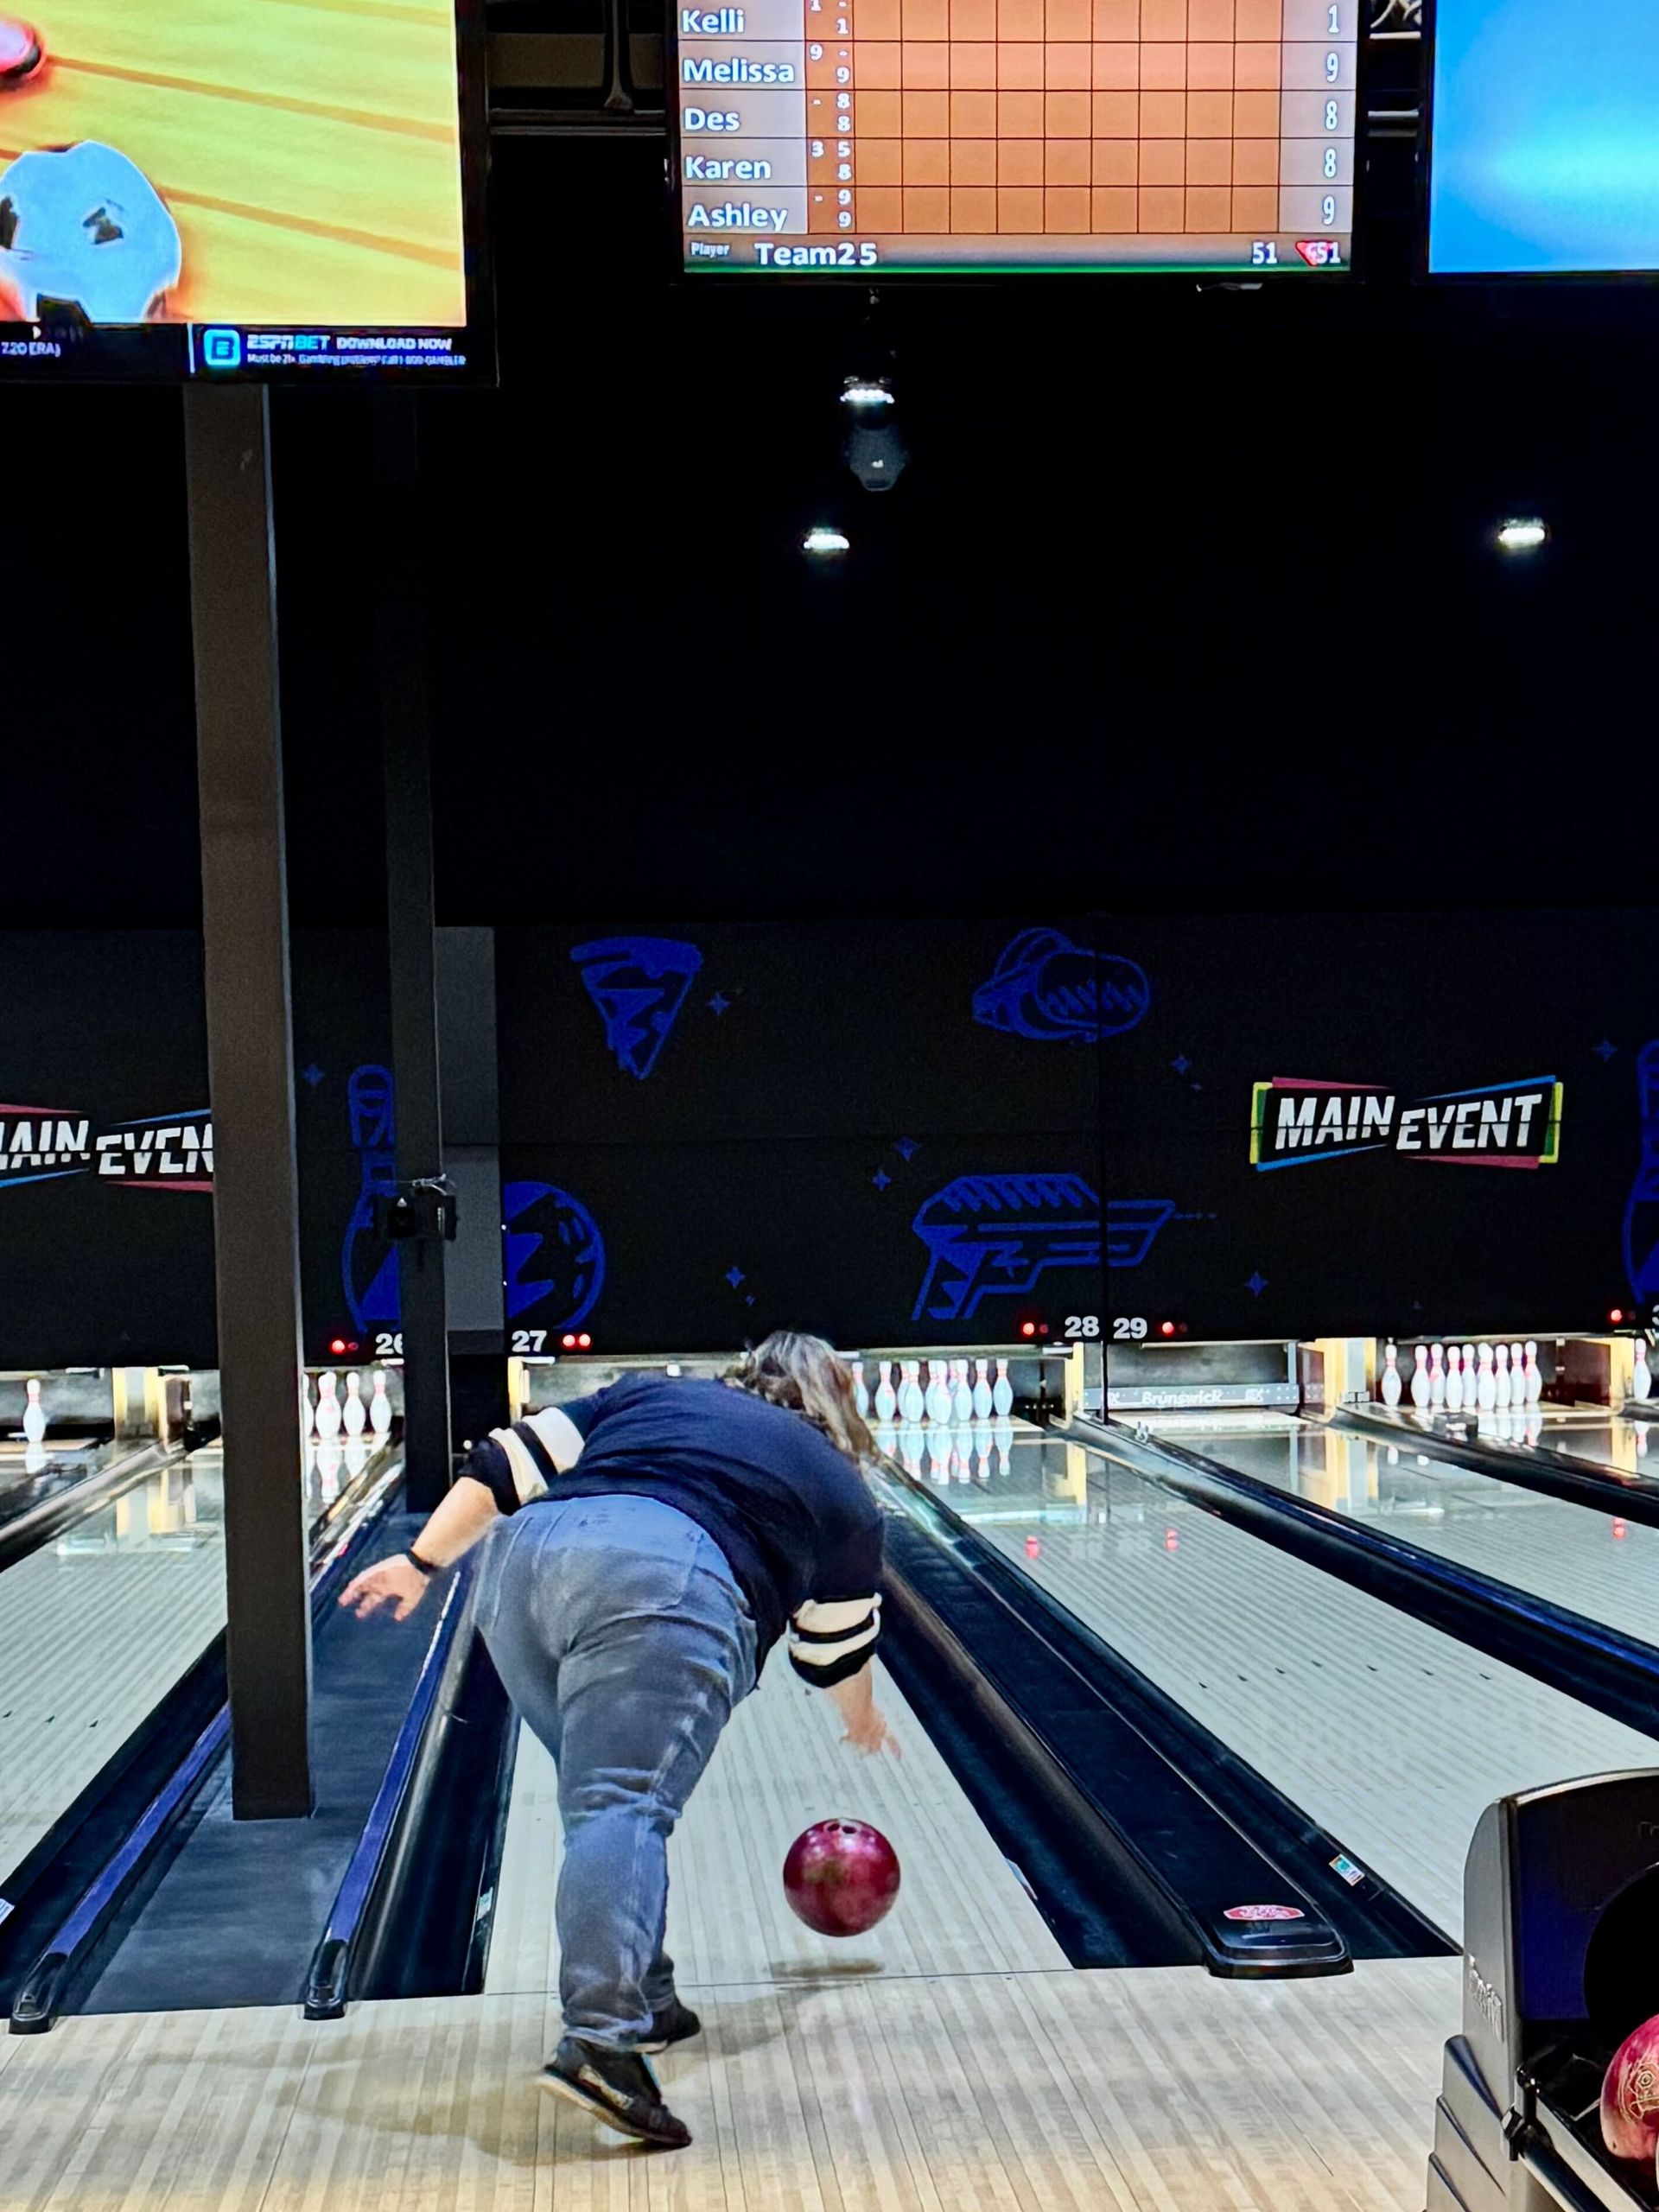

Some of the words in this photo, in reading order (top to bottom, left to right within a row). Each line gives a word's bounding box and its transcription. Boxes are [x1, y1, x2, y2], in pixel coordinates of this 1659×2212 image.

[682, 10, 745, 33] Kelli
[837, 18, 849, 35] 1
[1327, 4, 1339, 33] 1
[810, 44, 823, 60] 9
[683, 59, 795, 82] Melissa
[837, 67, 850, 83] 9
[1326, 53, 1338, 82] 9
[836, 92, 850, 109] 8
[683, 107, 741, 131] Des
[837, 116, 850, 131] 8
[1325, 100, 1338, 130] 8
[810, 141, 823, 157] 3
[837, 141, 850, 157] 5
[684, 156, 772, 180] Karen
[1325, 148, 1337, 178] 8
[838, 189, 851, 205] 9
[688, 203, 787, 232] Ashley
[838, 212, 851, 229] 9
[1322, 195, 1335, 226] 9
[691, 242, 729, 257] Player
[754, 243, 877, 265] Team25
[1252, 242, 1277, 264] 51
[336, 337, 416, 351] DOWNLOAD
[418, 338, 453, 351] NOW
[1275, 1096, 1395, 1150] MAIN
[1396, 1094, 1542, 1150] EVENT
[0, 1120, 91, 1170] AIN
[96, 1123, 213, 1174] EVEN
[1065, 1316, 1099, 1338] 28
[1113, 1318, 1147, 1339] 29
[512, 1330, 547, 1352] 27
[1141, 1388, 1223, 1405] Brunswick
